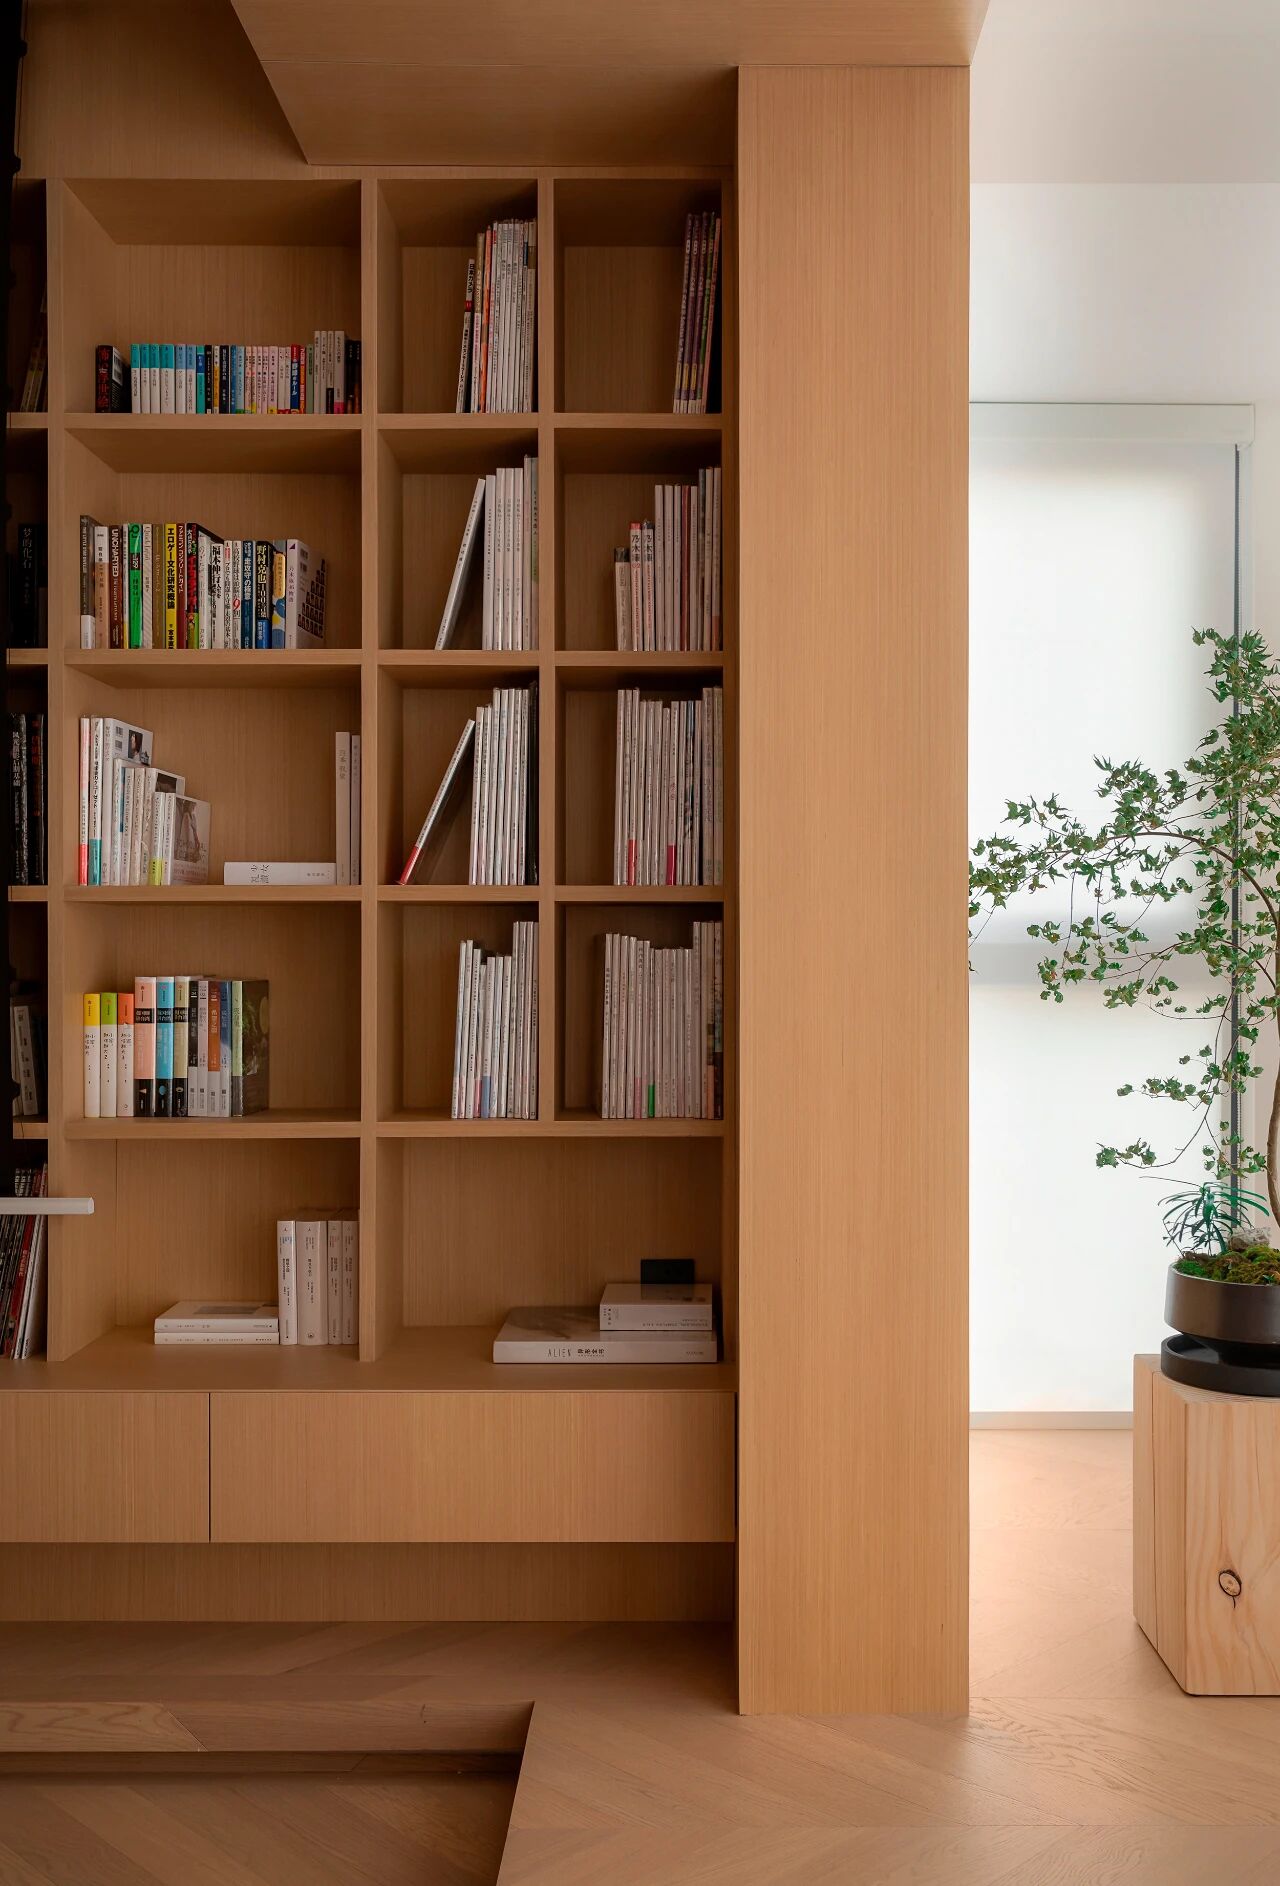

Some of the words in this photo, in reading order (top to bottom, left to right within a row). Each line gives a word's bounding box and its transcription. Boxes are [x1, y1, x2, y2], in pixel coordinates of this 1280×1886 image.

[23, 528, 32, 569] 梦的化石
[256, 545, 267, 584] 野村克也
[548, 1348, 571, 1358] ALIEN
